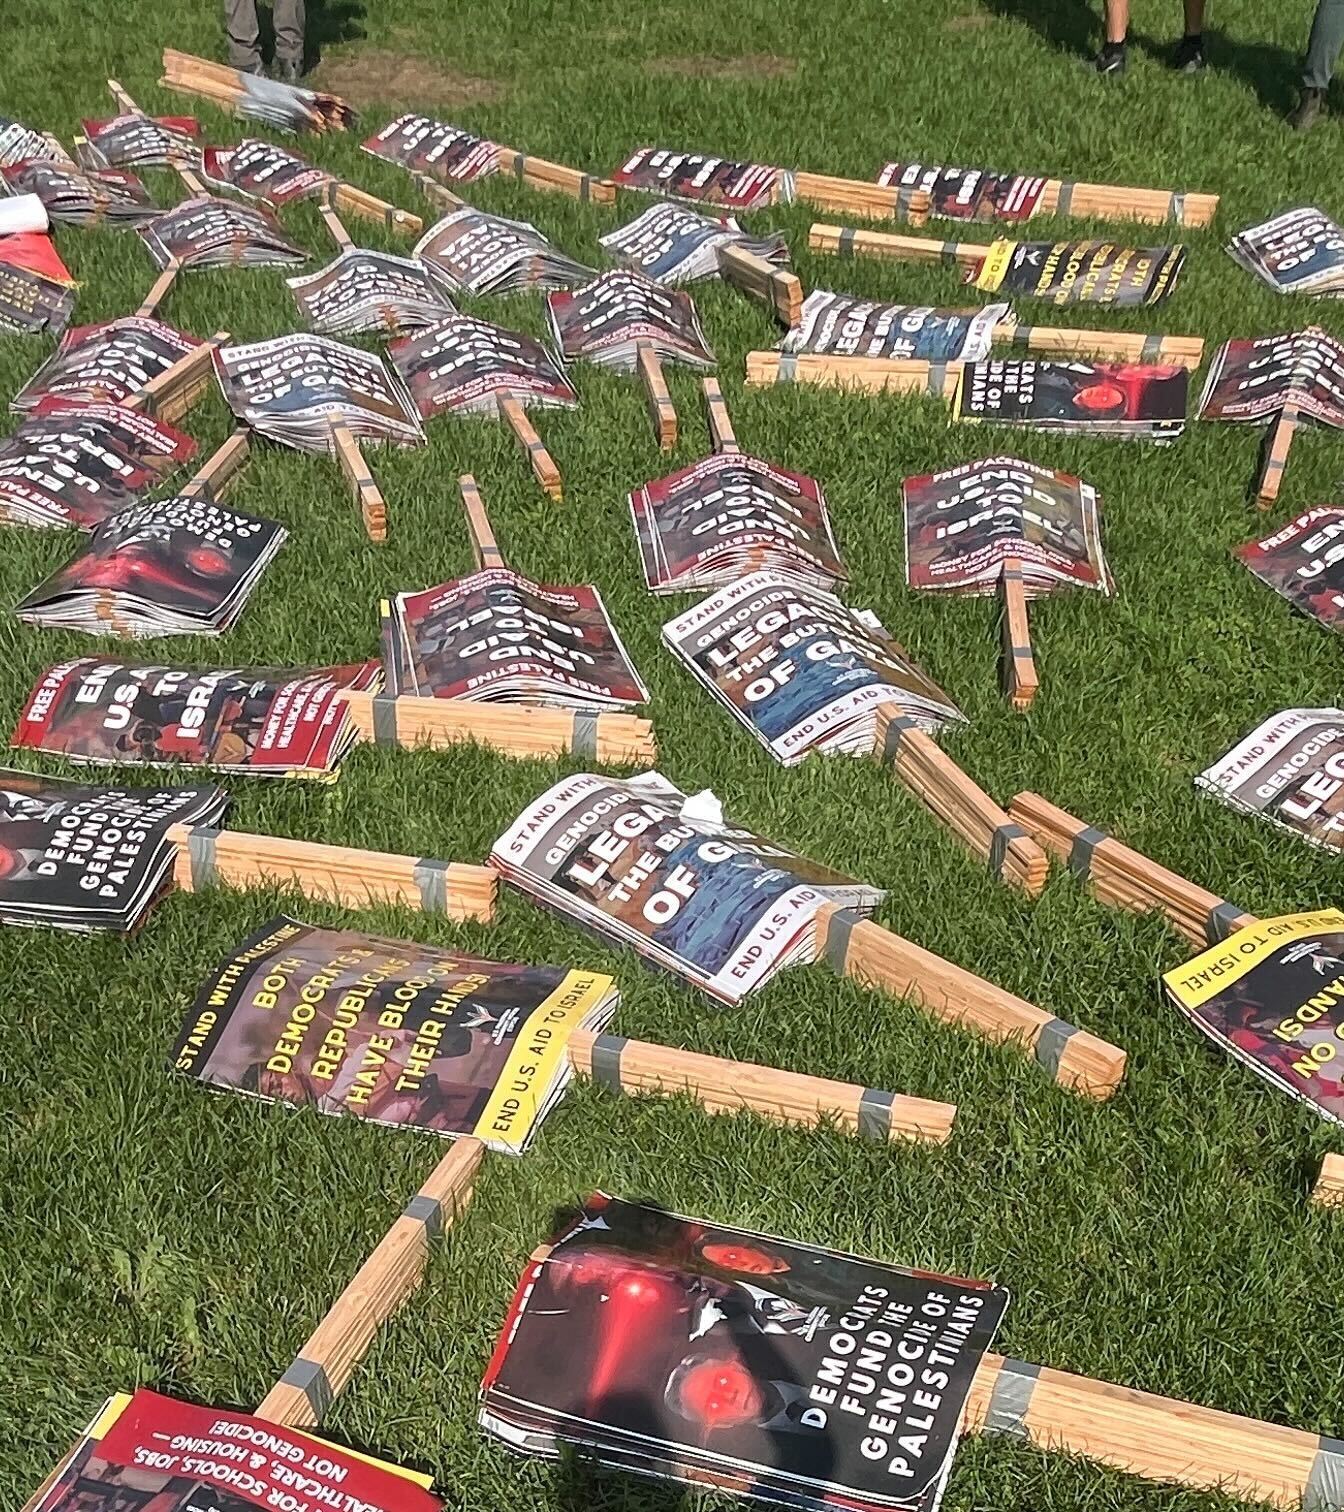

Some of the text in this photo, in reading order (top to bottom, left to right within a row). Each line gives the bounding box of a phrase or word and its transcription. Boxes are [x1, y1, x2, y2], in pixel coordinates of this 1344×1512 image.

[959, 470, 1034, 490] END
[975, 493, 1023, 508] TO
[996, 481, 1056, 506] AID
[1258, 525, 1301, 552] FREE
[459, 632, 530, 659] AID
[495, 617, 549, 636] TO
[489, 645, 576, 672] END
[725, 646, 779, 682] THE
[743, 659, 797, 701] OF
[27, 688, 54, 723] FREE
[152, 670, 189, 697] TO
[510, 776, 597, 854] STAND WITH
[65, 811, 106, 867] FUND
[608, 851, 661, 903] THE
[641, 863, 698, 926] OF
[174, 956, 246, 1072] STAND WITH
[267, 957, 361, 1074] DEMOCRATS
[311, 957, 412, 1080] REPUBLICANS
[347, 971, 431, 1105] HAVE BLOOD
[394, 1018, 448, 1093] THEIR
[491, 976, 595, 1133] END U.S. AID TO ISRAEL
[1292, 1042, 1337, 1080] ON
[840, 1302, 914, 1416] FUND THE
[860, 1292, 951, 1461] GENOCIDE OF
